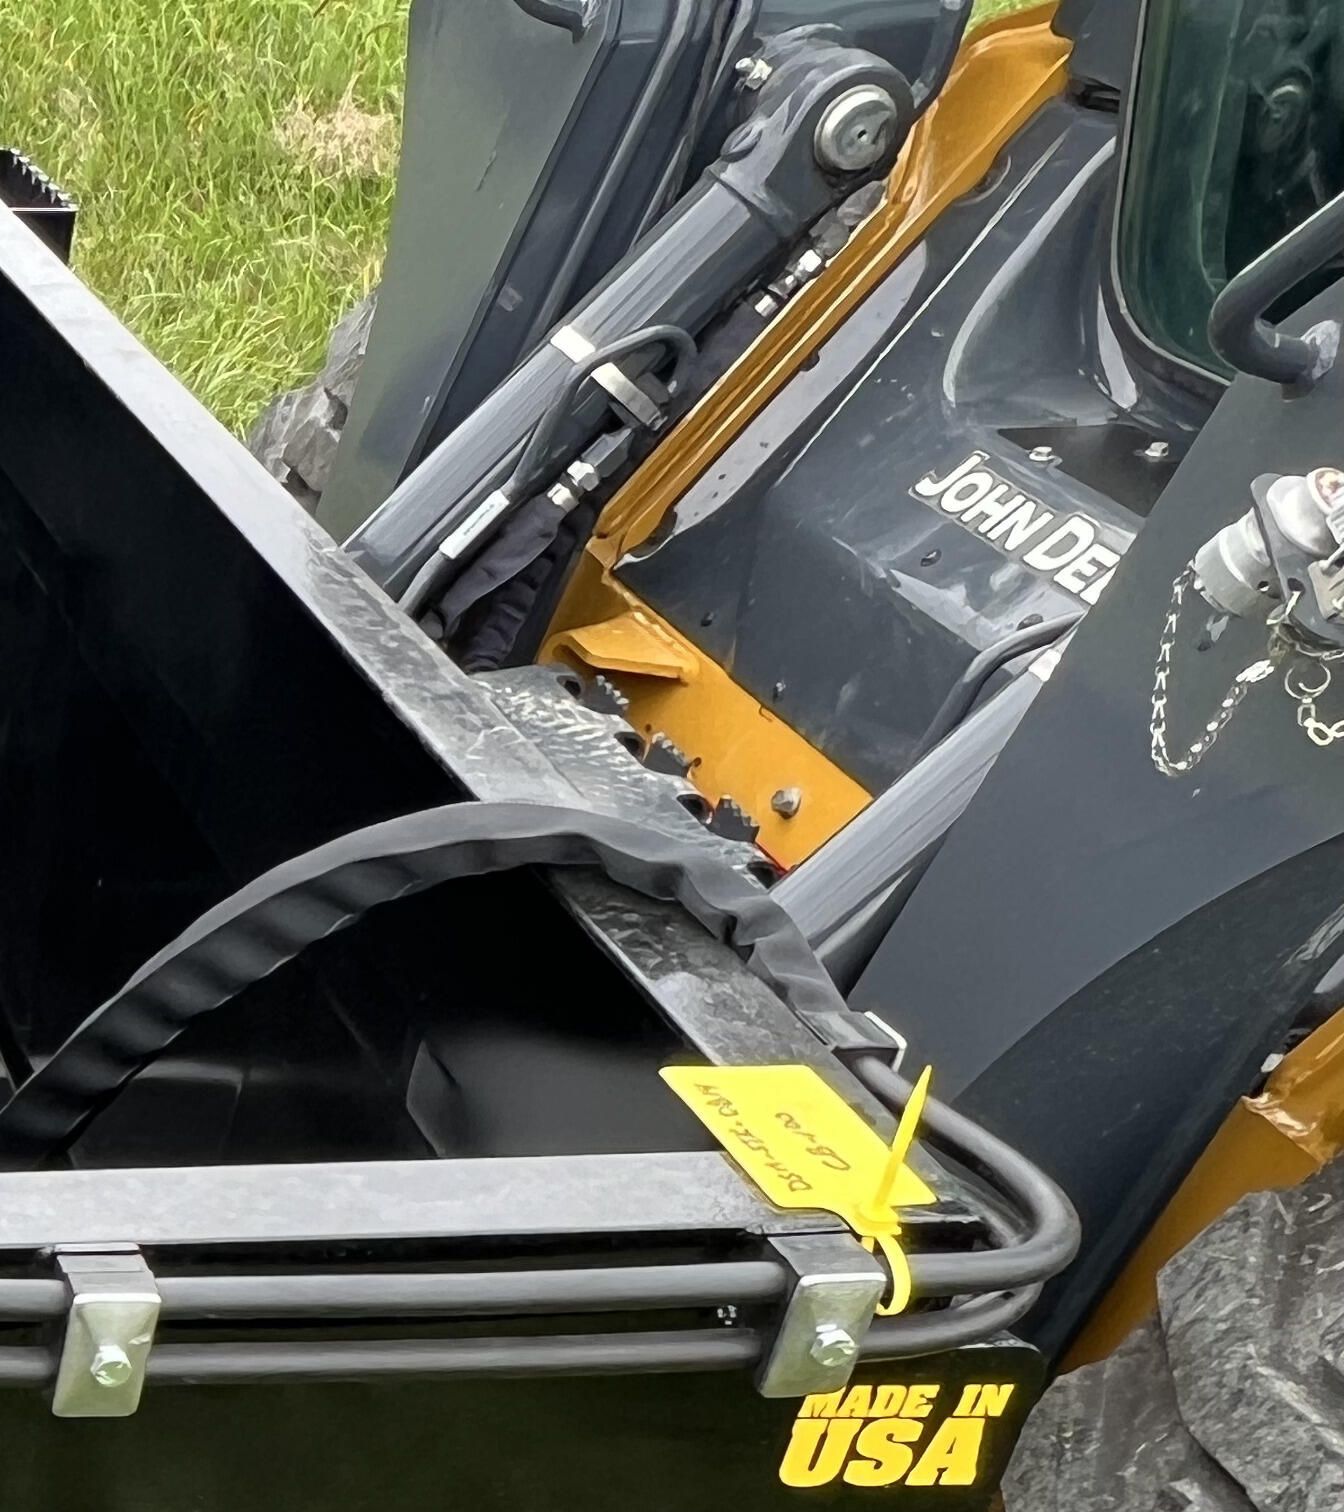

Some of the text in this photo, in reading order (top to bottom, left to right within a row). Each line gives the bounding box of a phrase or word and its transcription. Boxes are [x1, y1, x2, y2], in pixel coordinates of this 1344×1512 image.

[914, 453, 1055, 551] JOHN
[797, 1384, 1015, 1418] MADE IN
[779, 1416, 986, 1487] USA
